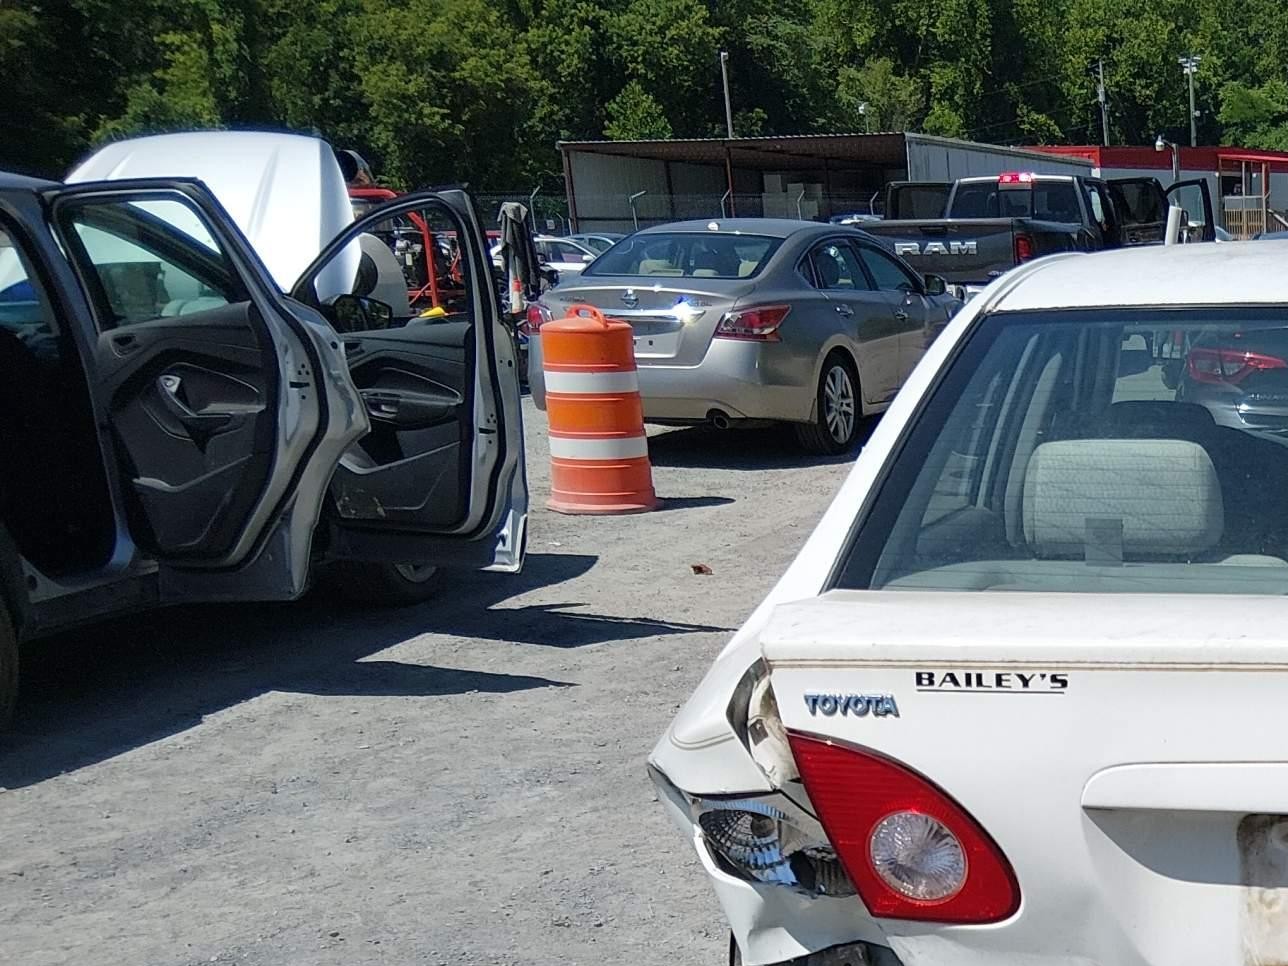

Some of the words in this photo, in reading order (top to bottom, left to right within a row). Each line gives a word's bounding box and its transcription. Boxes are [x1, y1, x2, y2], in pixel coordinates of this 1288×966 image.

[894, 241, 977, 256] RAM
[915, 671, 1069, 690] BAILEY'S
[804, 693, 900, 718] TOYOTA
